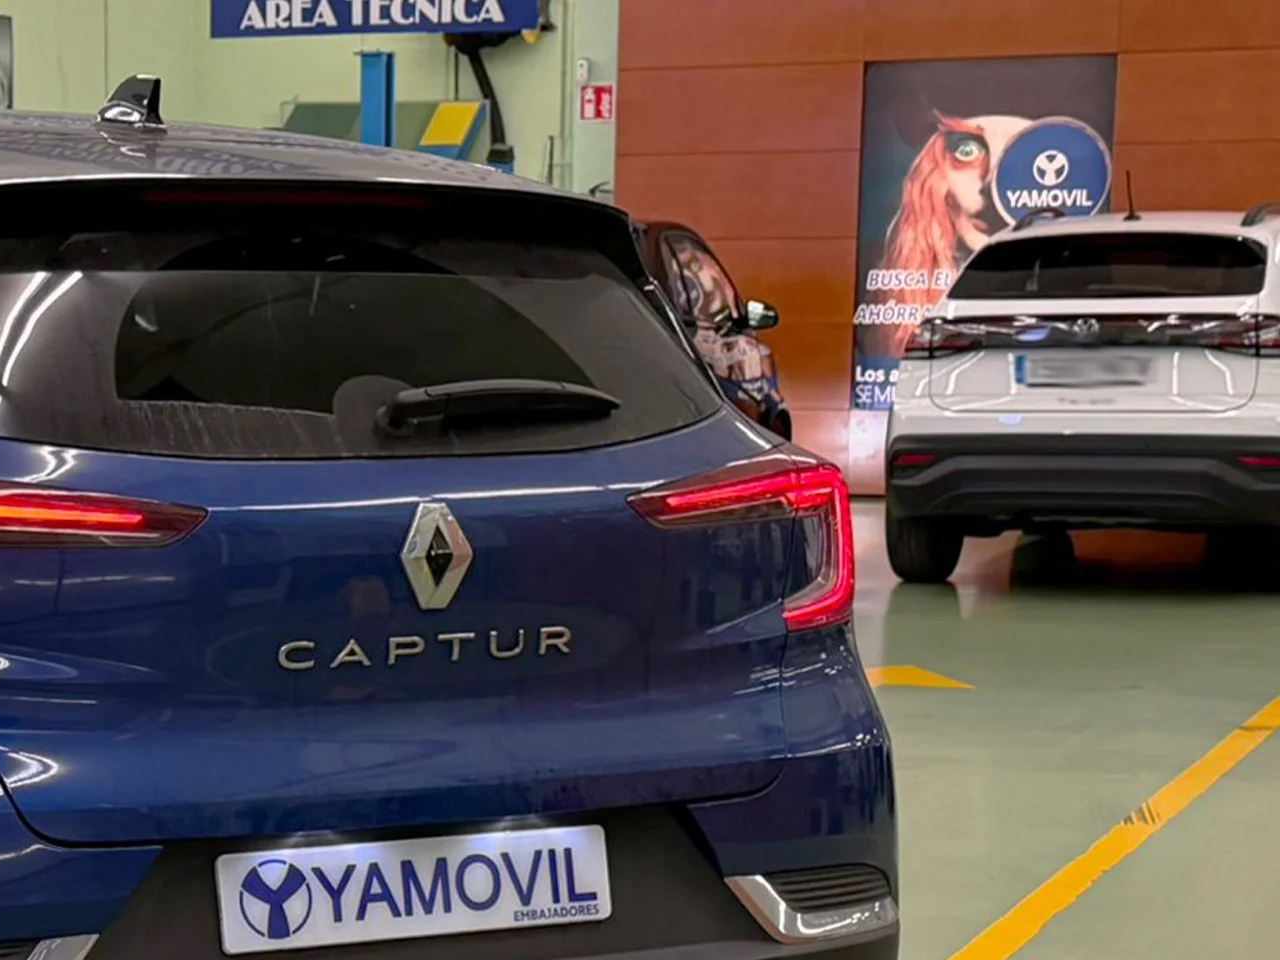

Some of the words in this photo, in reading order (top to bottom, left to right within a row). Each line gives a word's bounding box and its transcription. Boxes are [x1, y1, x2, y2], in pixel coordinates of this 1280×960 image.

[1006, 188, 1093, 208] YAMOVIL
[867, 270, 927, 289] BUSCA
[855, 364, 885, 383] Los
[277, 625, 572, 671] CAPTUR
[311, 846, 598, 923] YAMOVIL
[513, 904, 600, 922] EMBAJADORES
